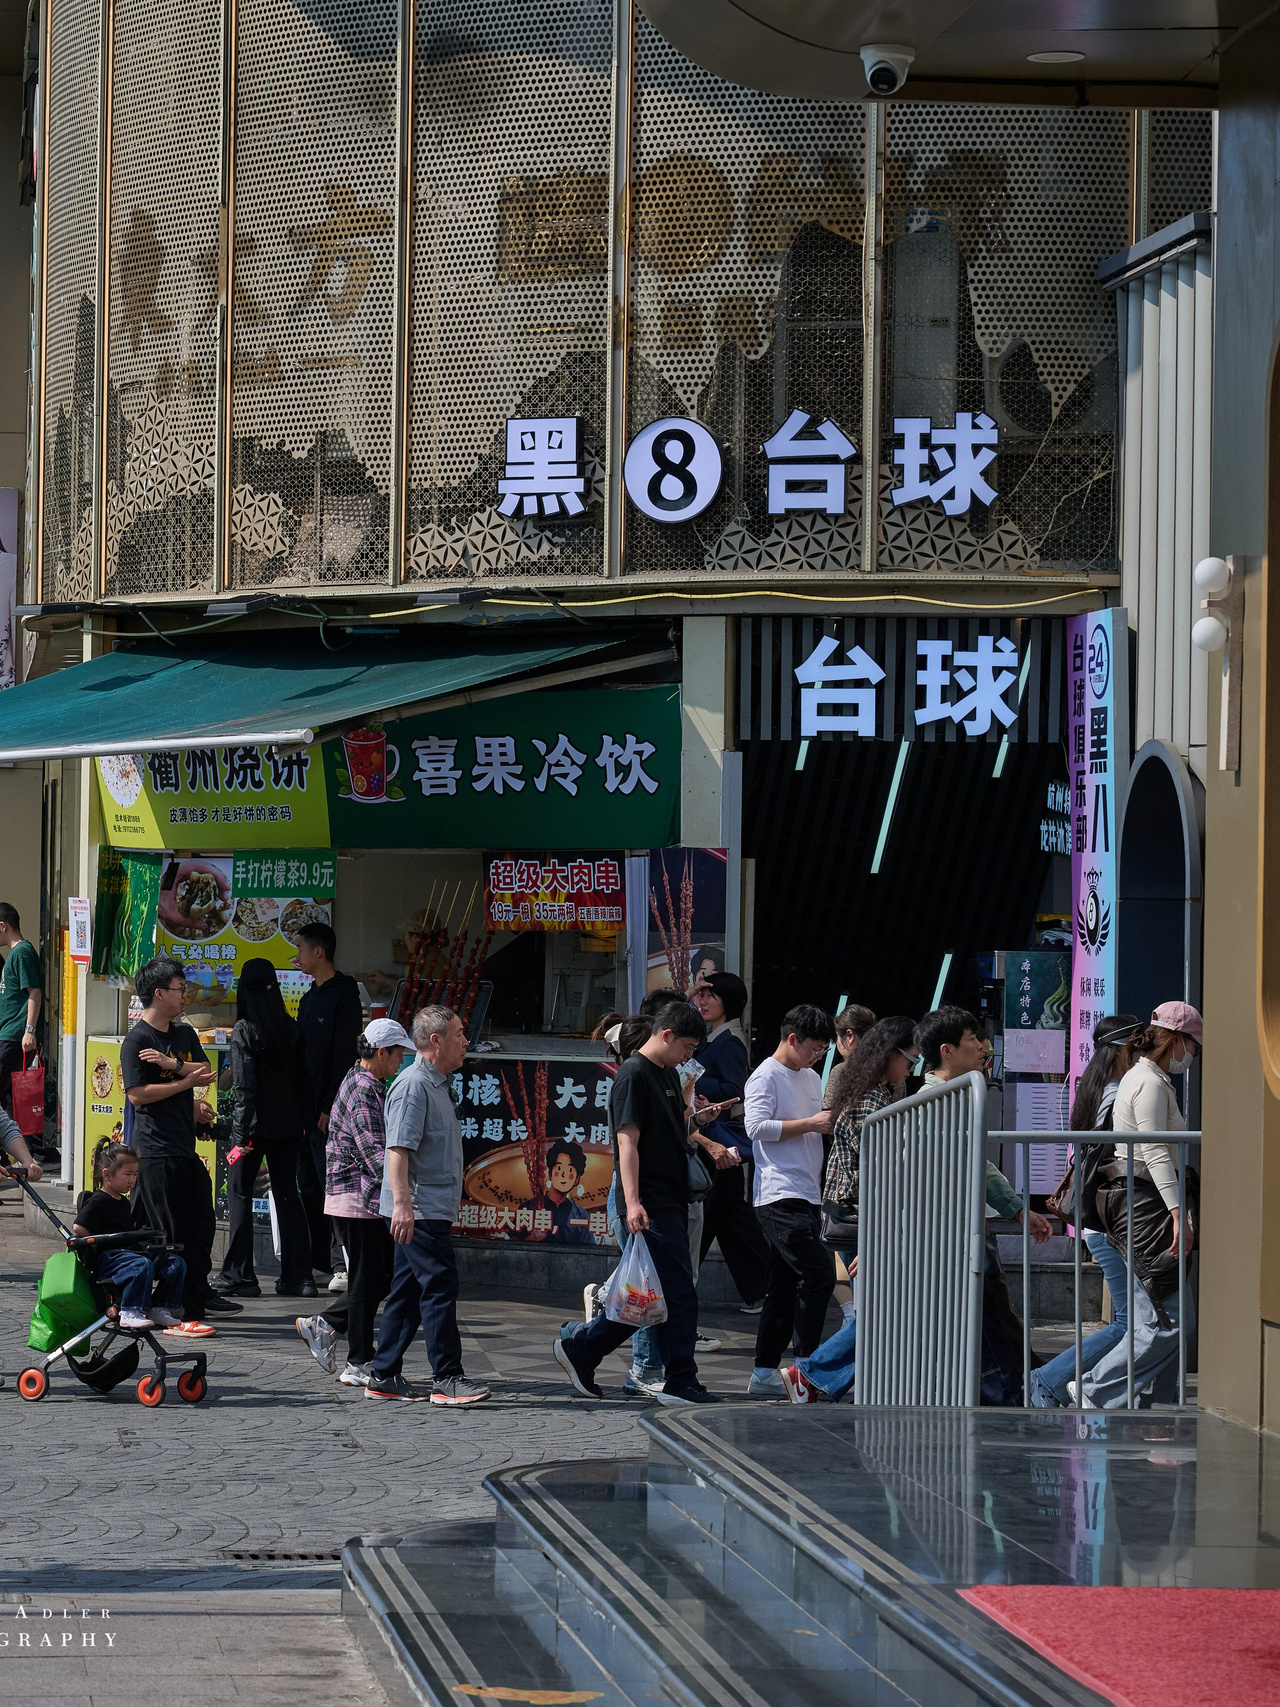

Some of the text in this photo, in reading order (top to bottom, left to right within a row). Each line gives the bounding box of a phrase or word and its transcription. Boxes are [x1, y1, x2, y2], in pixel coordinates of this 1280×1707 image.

[794, 635, 1018, 737] 台球
[1088, 643, 1104, 674] 24
[410, 733, 659, 797] 喜果冷饮
[1072, 633, 1087, 853] 台球俱乐部
[1089, 706, 1109, 853] 黑八
[234, 859, 334, 889] 手打柠檬茶9.9元
[490, 858, 621, 894] 超级大肉串
[490, 901, 531, 921] 19元一根
[534, 901, 576, 921] 35元两根
[1019, 959, 1032, 1025] 本店特色
